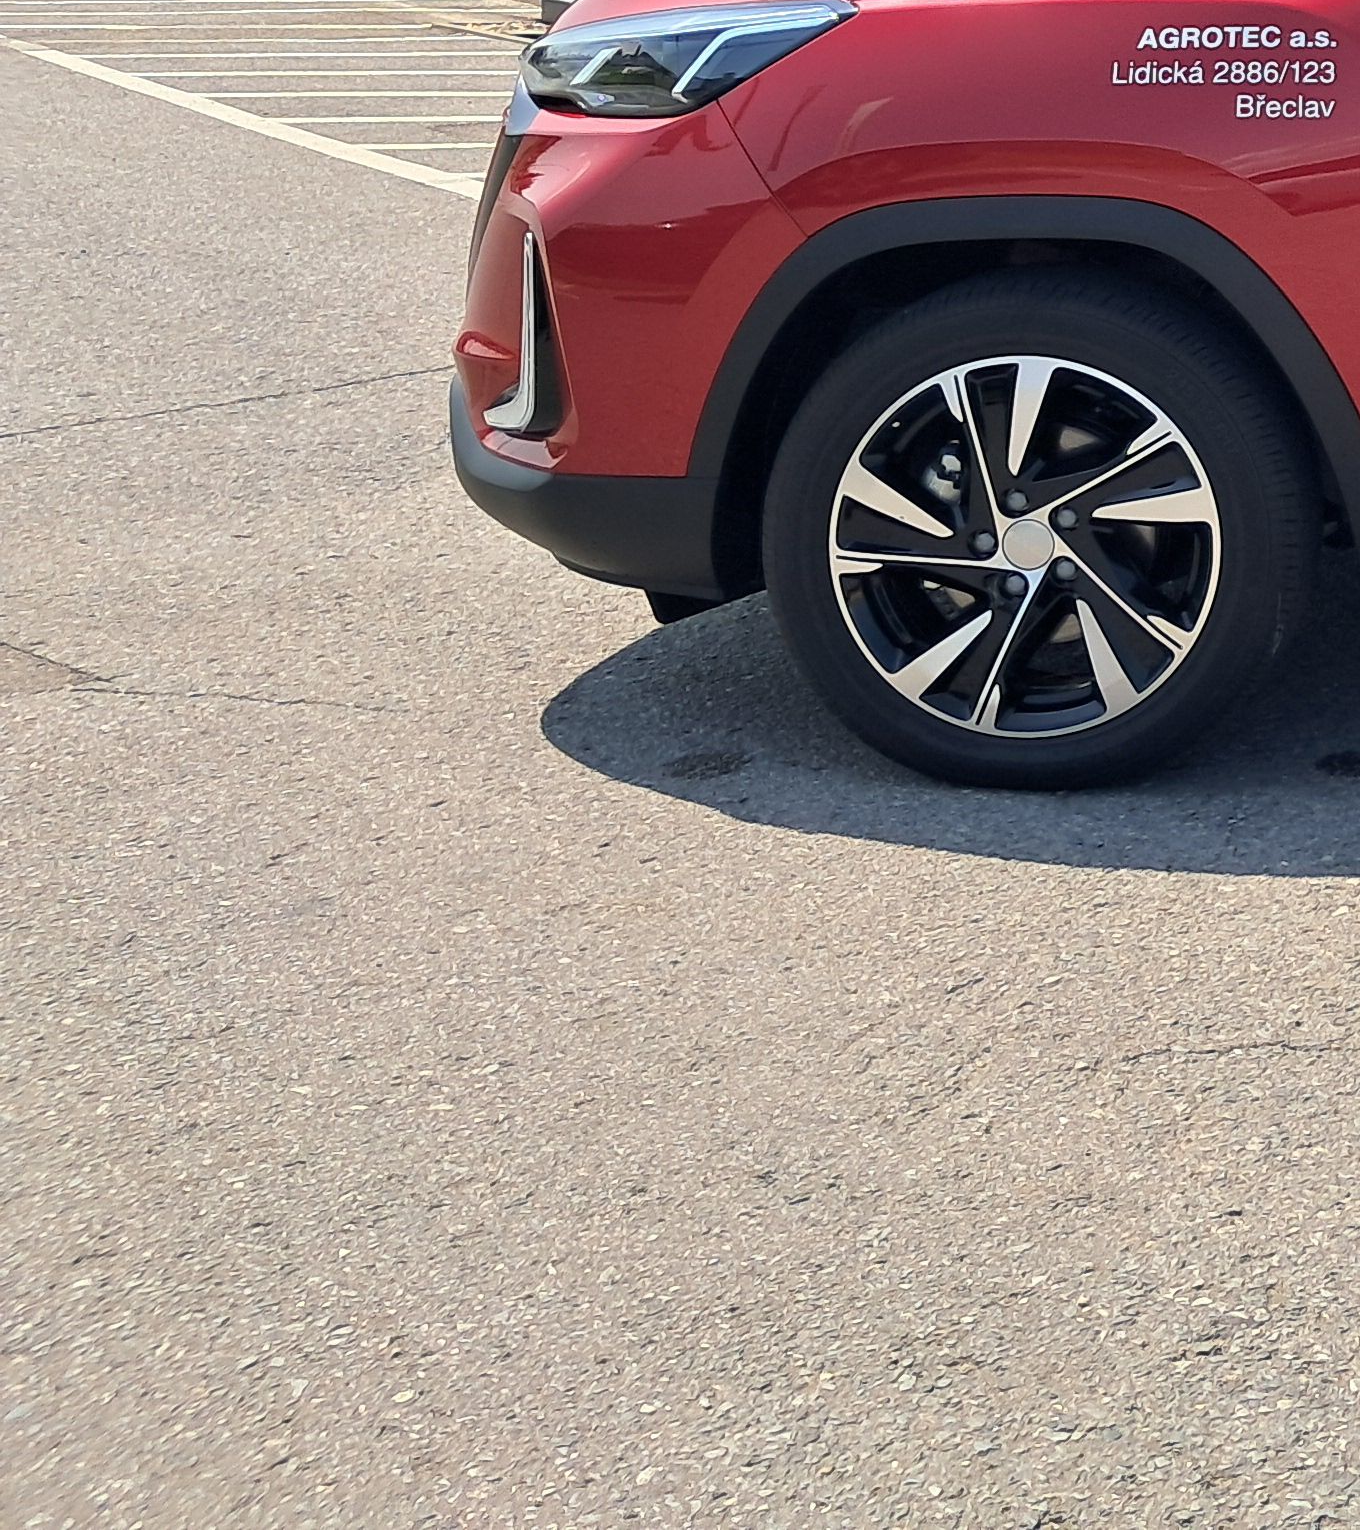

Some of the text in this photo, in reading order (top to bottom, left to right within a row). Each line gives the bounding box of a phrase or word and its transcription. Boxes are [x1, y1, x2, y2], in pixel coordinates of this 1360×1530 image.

[1137, 25, 1338, 50] AGROTEC a.s.
[1111, 59, 1336, 86] Lidická 2886/123
[1234, 93, 1336, 120] Břeclav
